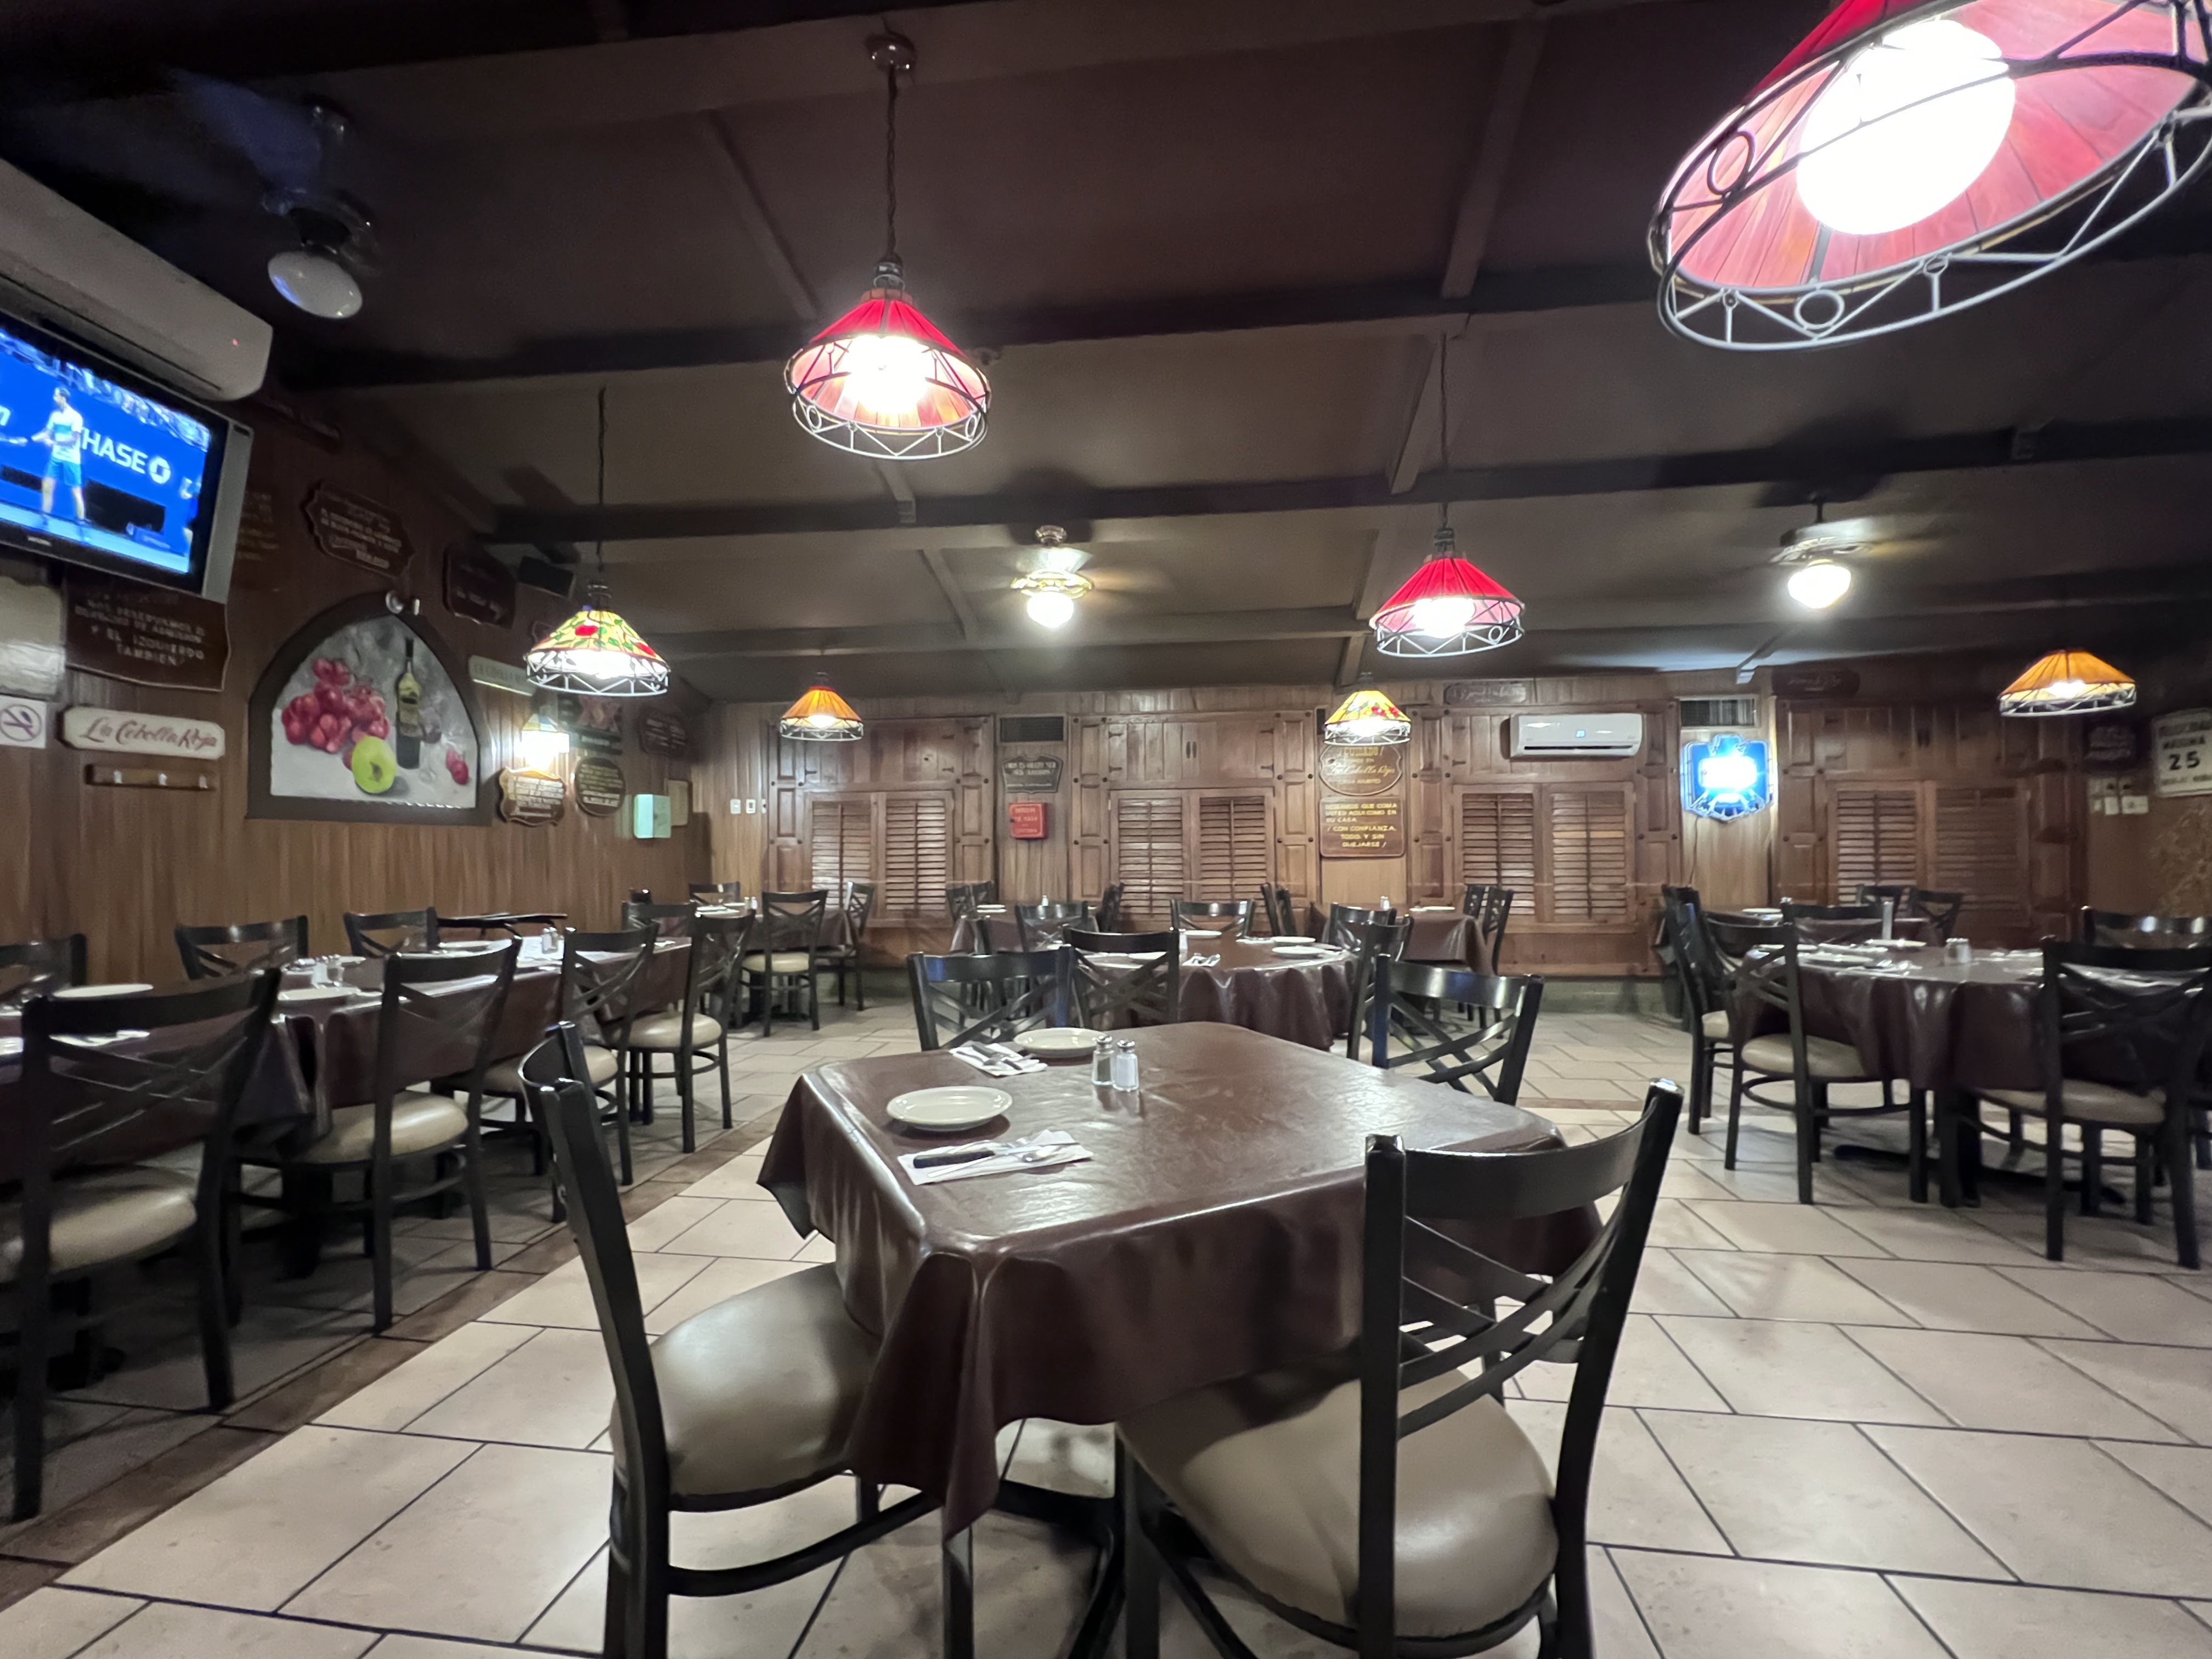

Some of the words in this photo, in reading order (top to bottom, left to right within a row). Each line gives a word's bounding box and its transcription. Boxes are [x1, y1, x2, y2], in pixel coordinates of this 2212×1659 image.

[82, 427, 149, 475] HASE
[80, 716, 113, 743] La
[2169, 751, 2200, 770] 25
